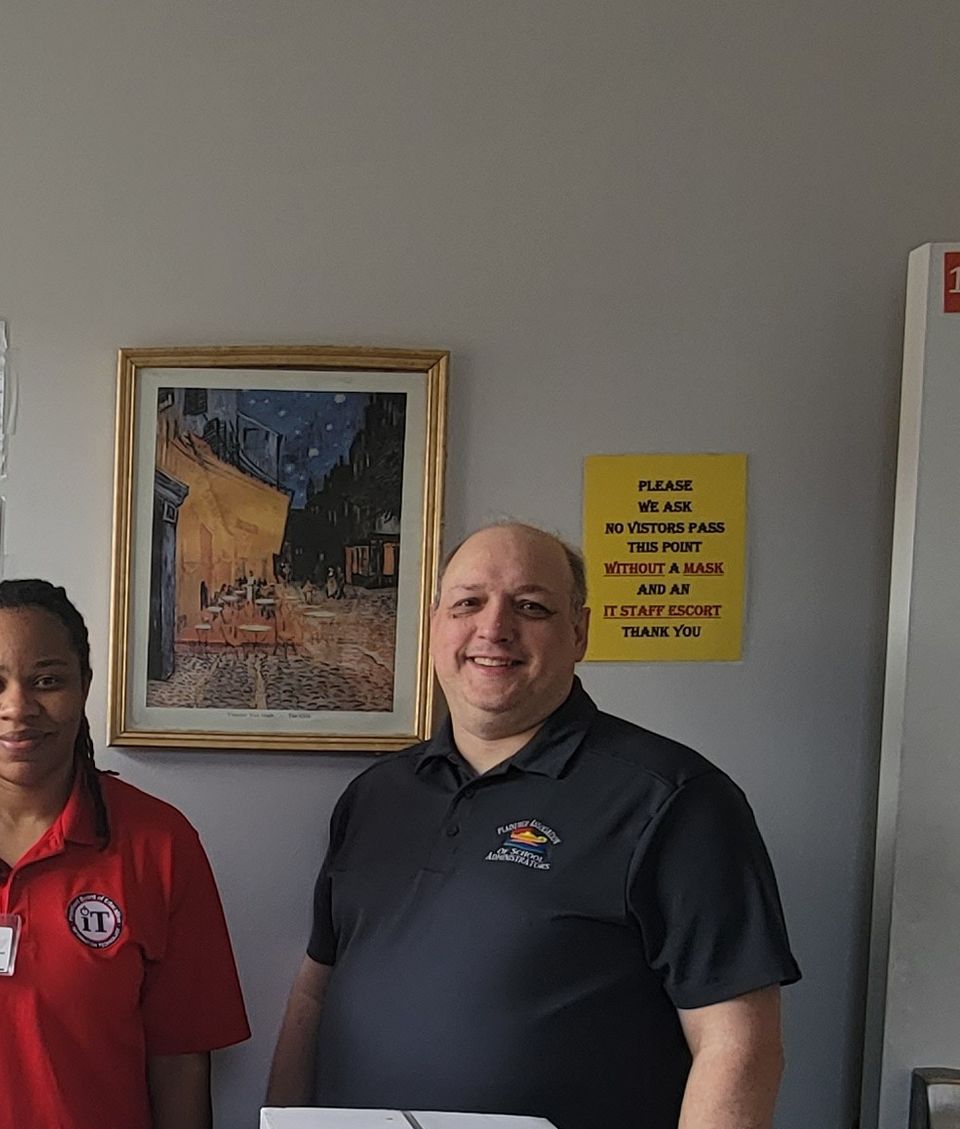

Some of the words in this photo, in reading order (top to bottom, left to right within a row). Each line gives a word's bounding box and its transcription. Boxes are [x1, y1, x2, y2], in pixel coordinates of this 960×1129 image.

[638, 480, 692, 492] PLEASE
[638, 501, 659, 512] WE
[663, 502, 692, 512] ASK
[605, 523, 624, 534] NO
[627, 522, 684, 534] VISTORS
[688, 523, 725, 533] PASS
[627, 542, 658, 553] THIS
[662, 542, 702, 553] POINT
[604, 561, 665, 574] WITHOUT
[669, 563, 680, 574] A
[683, 562, 724, 574] MASK
[637, 584, 666, 595] AND
[670, 584, 690, 595] AN
[604, 605, 617, 617] IT
[620, 605, 665, 617] STAFF
[668, 605, 722, 617] ESCORT
[622, 627, 670, 638] THANK
[673, 624, 701, 637] YOU
